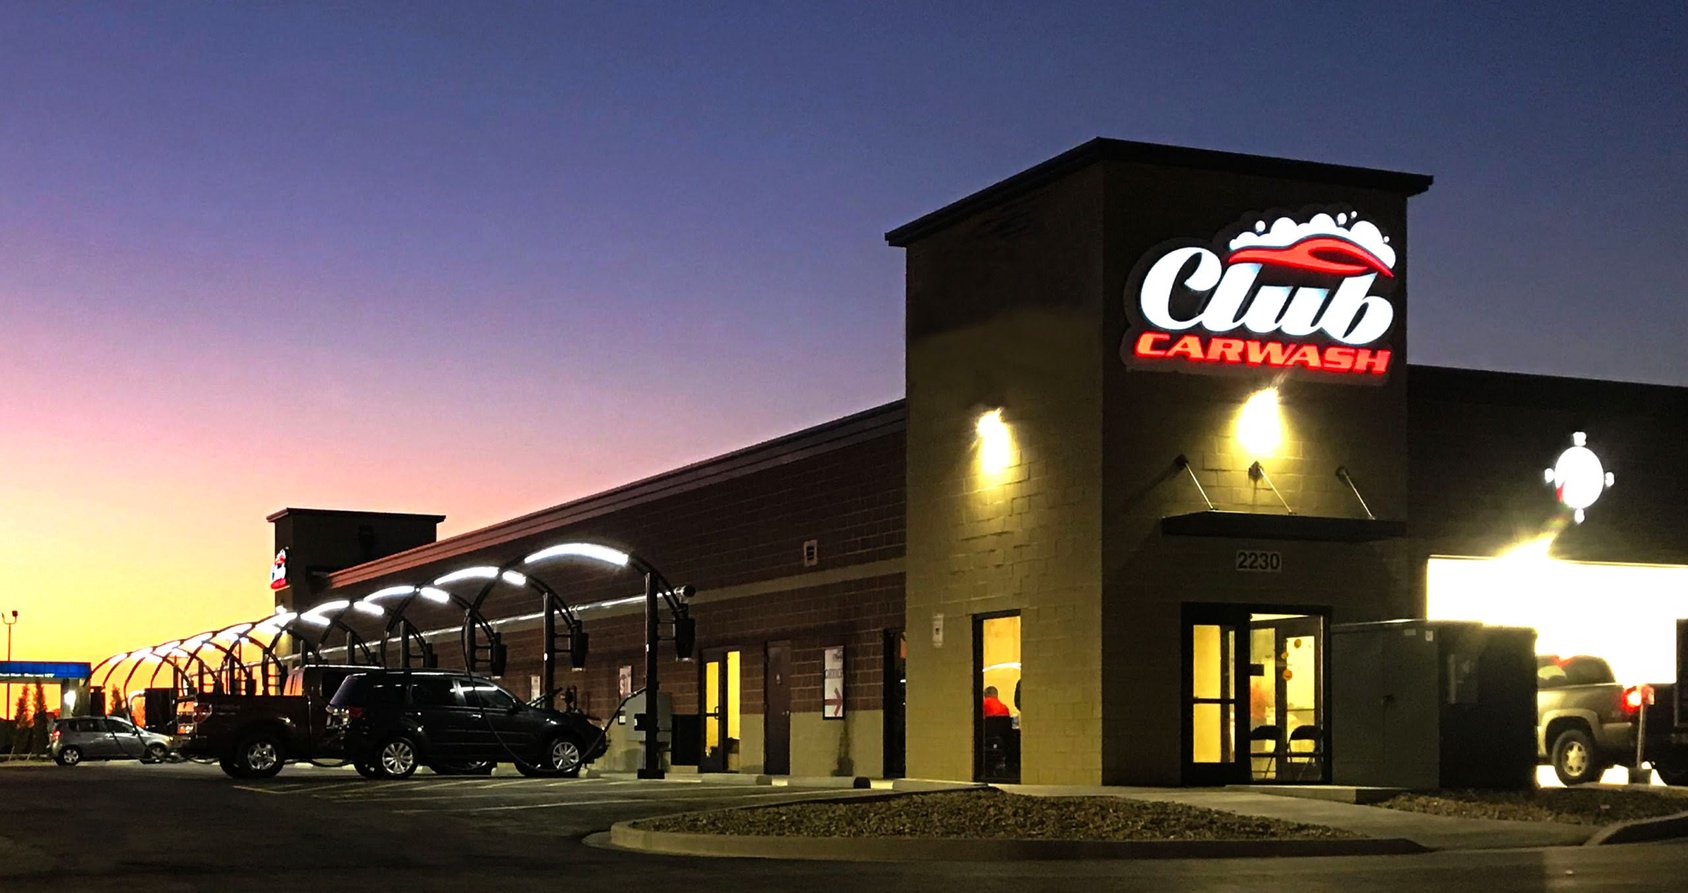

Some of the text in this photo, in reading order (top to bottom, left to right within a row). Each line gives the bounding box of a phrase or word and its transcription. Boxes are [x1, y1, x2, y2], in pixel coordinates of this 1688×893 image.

[1140, 247, 1394, 344] Club
[1136, 332, 1391, 374] CARWASH
[1235, 551, 1280, 570] 2230
